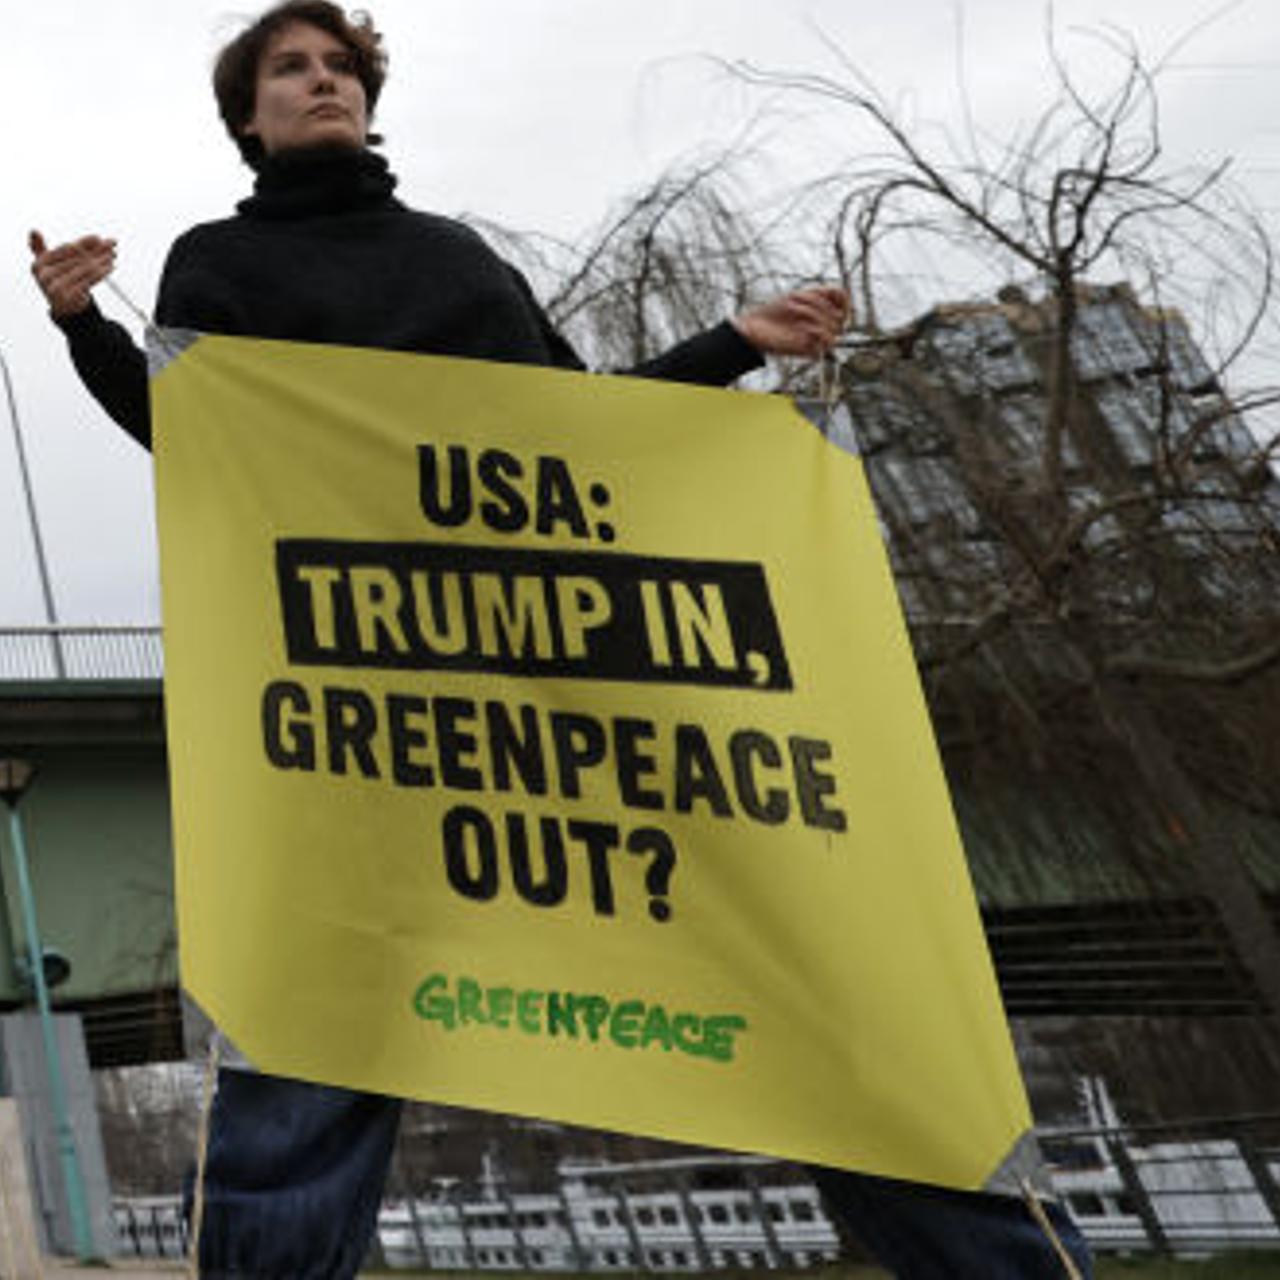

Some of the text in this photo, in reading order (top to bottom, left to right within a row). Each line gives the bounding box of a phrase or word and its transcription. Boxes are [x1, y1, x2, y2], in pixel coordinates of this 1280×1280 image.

[416, 443, 617, 542] USA:
[297, 564, 771, 684] TRUMP IN,
[261, 680, 848, 834] GREENPEACE
[442, 804, 678, 923] OUT?
[414, 974, 746, 1062] GREENPEACE
